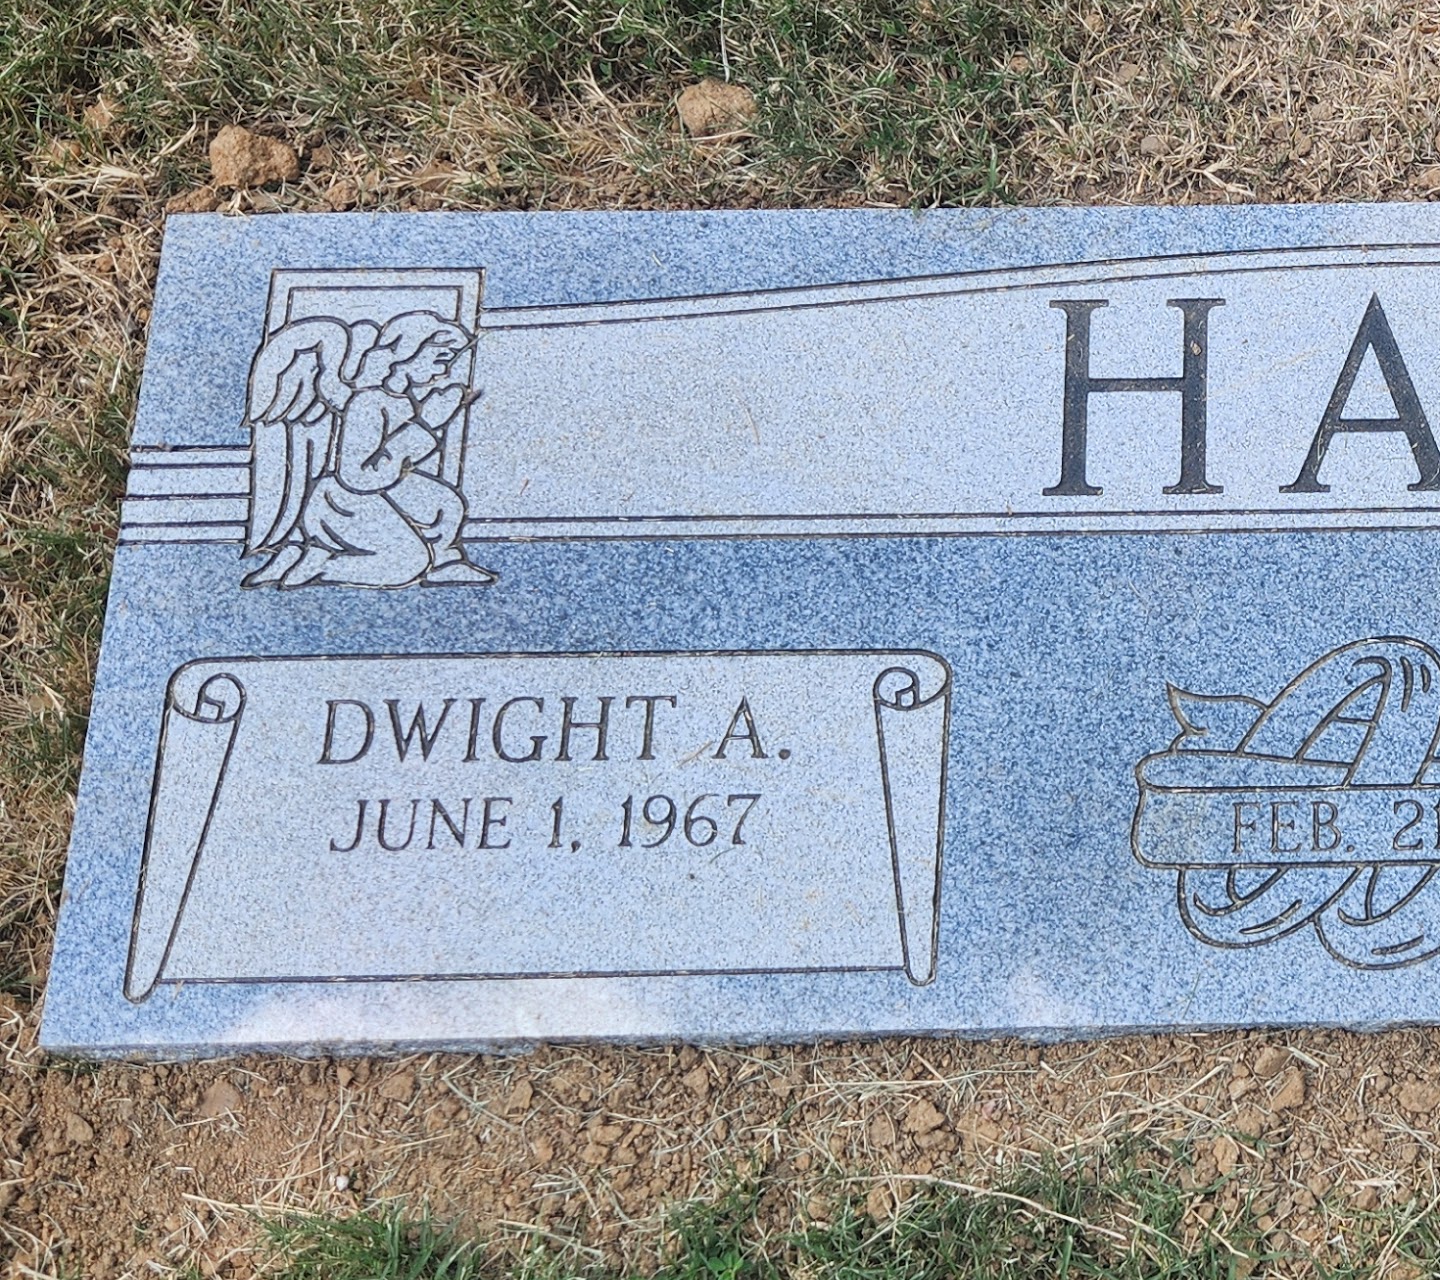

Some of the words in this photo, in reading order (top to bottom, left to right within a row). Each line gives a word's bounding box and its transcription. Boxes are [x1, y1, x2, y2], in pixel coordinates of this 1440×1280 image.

[316, 695, 677, 765] DWIGHT
[711, 695, 791, 760] A.
[329, 796, 513, 852] JUNE
[547, 796, 581, 853] 1,
[617, 793, 762, 848] 1967
[1231, 798, 1354, 854] FEB.
